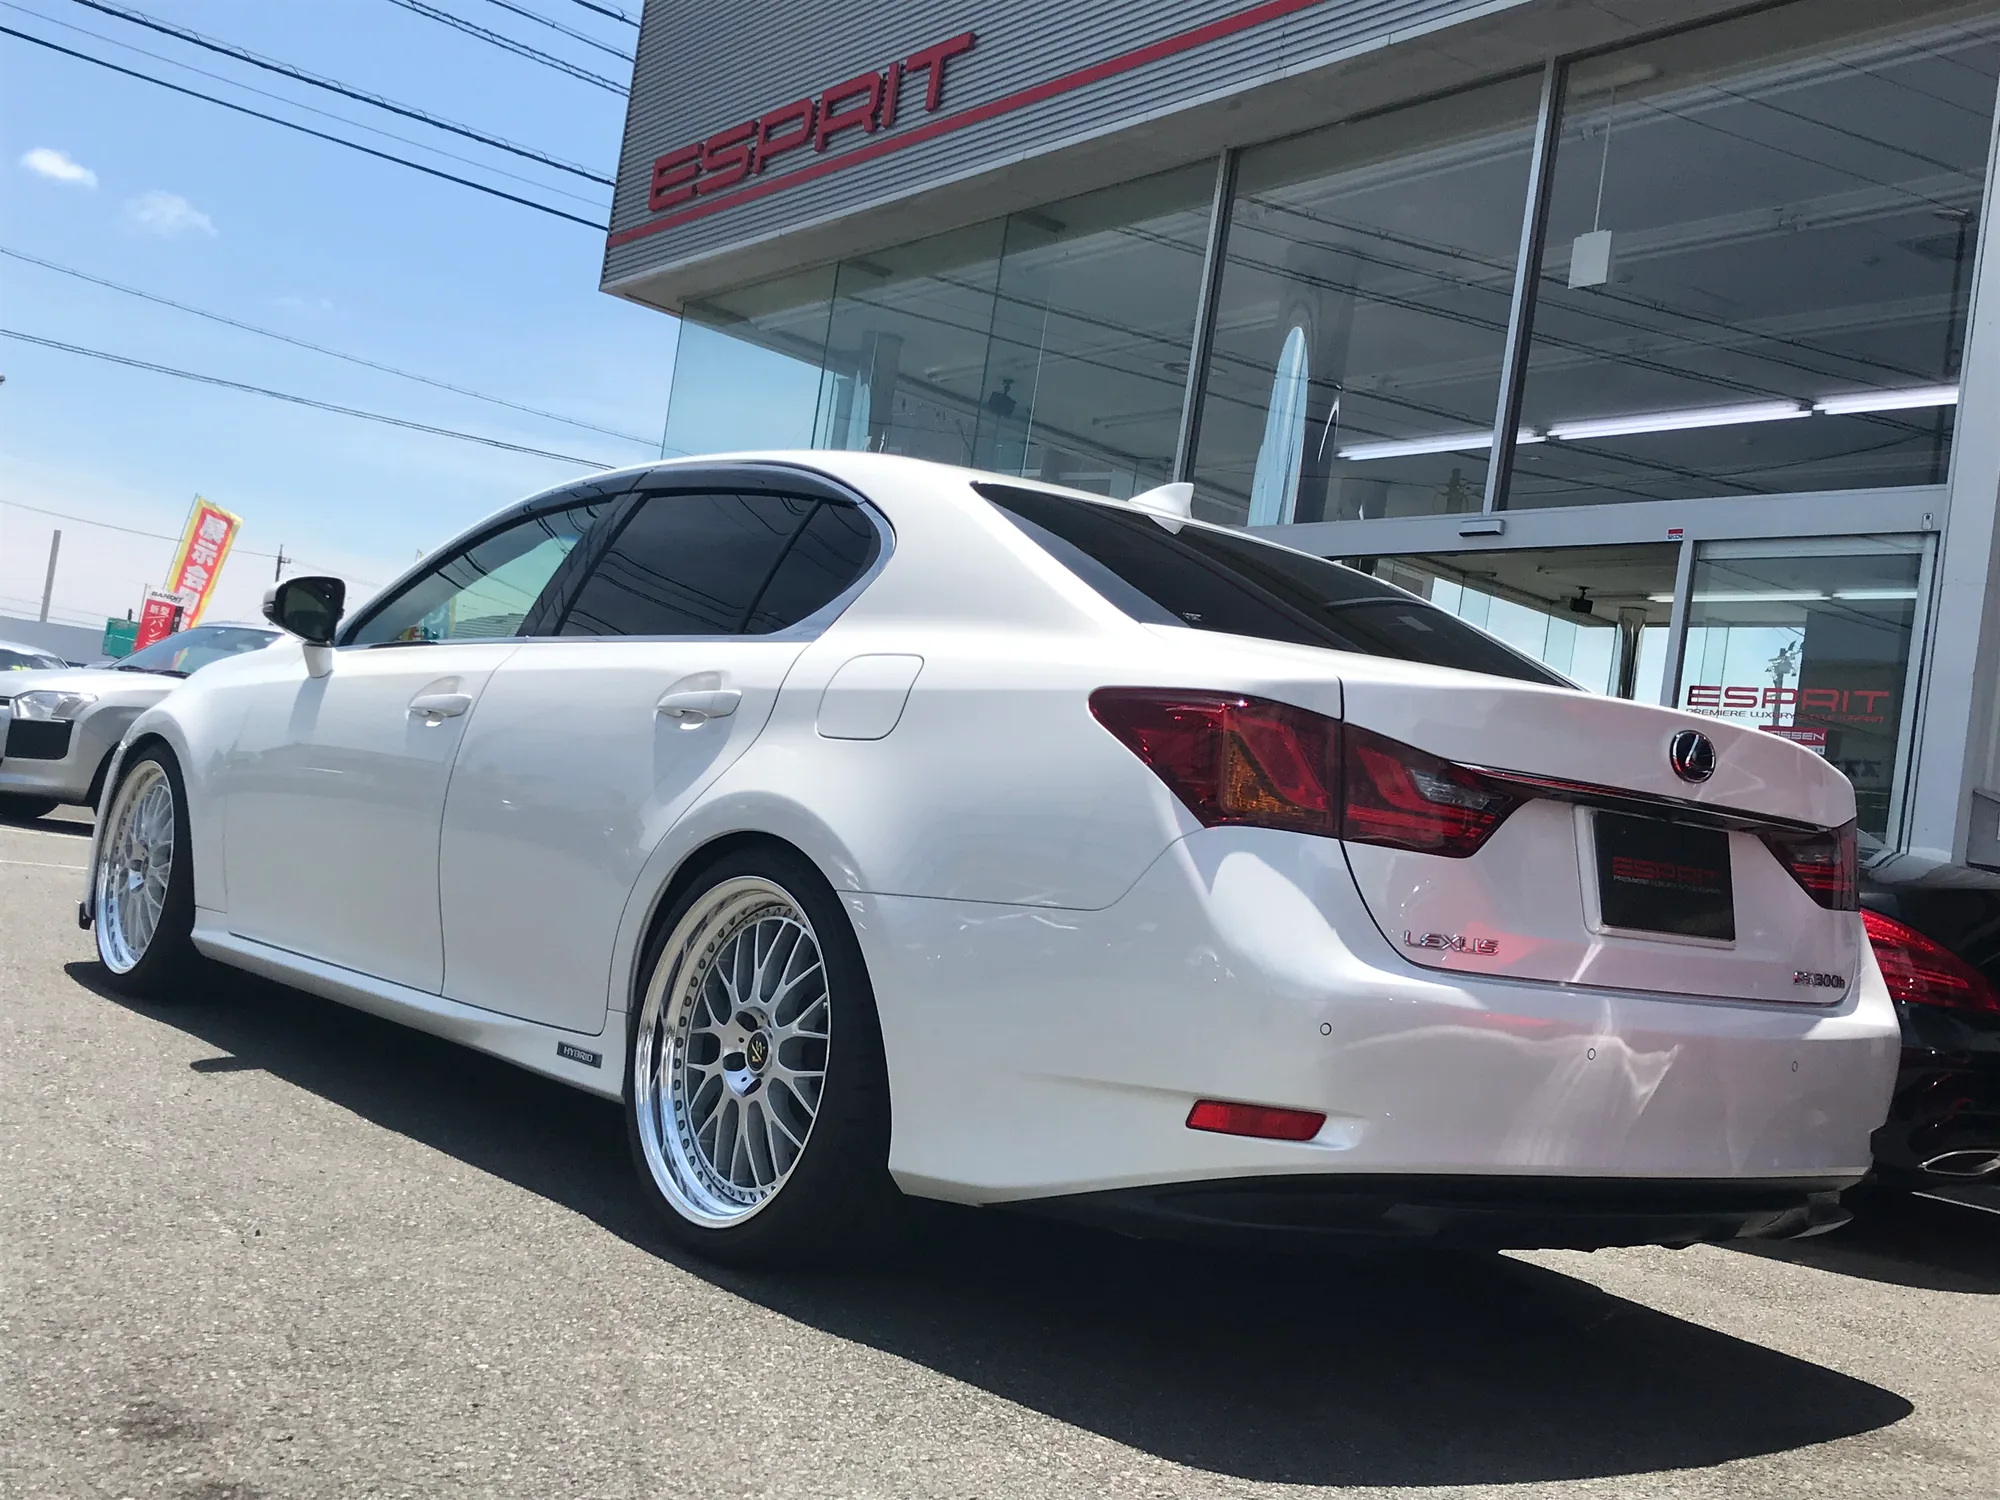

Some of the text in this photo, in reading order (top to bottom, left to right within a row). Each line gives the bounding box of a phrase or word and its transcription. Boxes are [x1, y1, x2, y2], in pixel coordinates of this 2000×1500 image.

[648, 31, 977, 212] ESPRIT
[151, 591, 184, 603] BANDIT
[1687, 686, 1889, 713] ESPRIT
[1685, 708, 1746, 718] PREMIERE
[1750, 711, 1795, 720] LUXURY
[1613, 856, 1719, 886] ESPRIT
[1404, 930, 1499, 956] LEXUS
[563, 1046, 593, 1063] HYBRID
